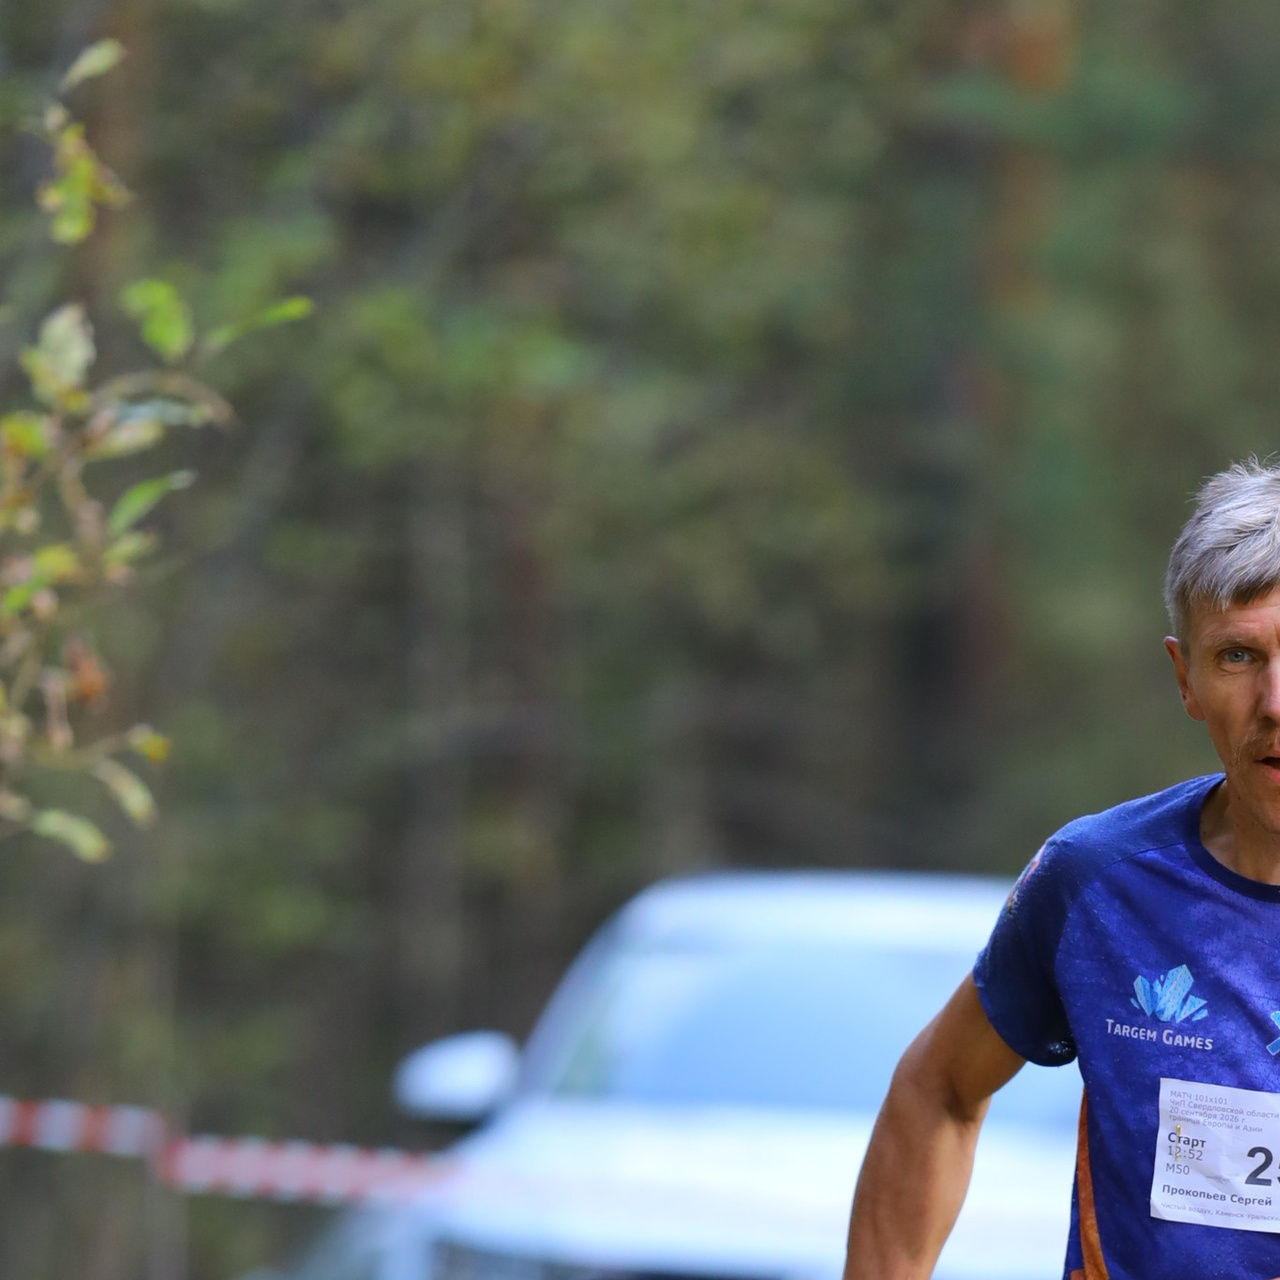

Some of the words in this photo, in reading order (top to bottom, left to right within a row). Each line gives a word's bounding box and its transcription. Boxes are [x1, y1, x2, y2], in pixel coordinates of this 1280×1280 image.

[1170, 1090, 1192, 1100] МАТЧ
[1169, 1106, 1179, 1114] 20
[1181, 1109, 1218, 1120] сентября
[1187, 1101, 1244, 1115] Свердловской
[1246, 1109, 1280, 1119] области
[1169, 1115, 1200, 1125] граница
[1203, 1120, 1233, 1130] Европы
[1242, 1124, 1263, 1133] Азии
[1167, 1132, 1206, 1148] Старт
[1167, 1145, 1203, 1162] 12:52
[1162, 1184, 1227, 1202] Прокопьев
[1230, 1193, 1272, 1207] Сергей
